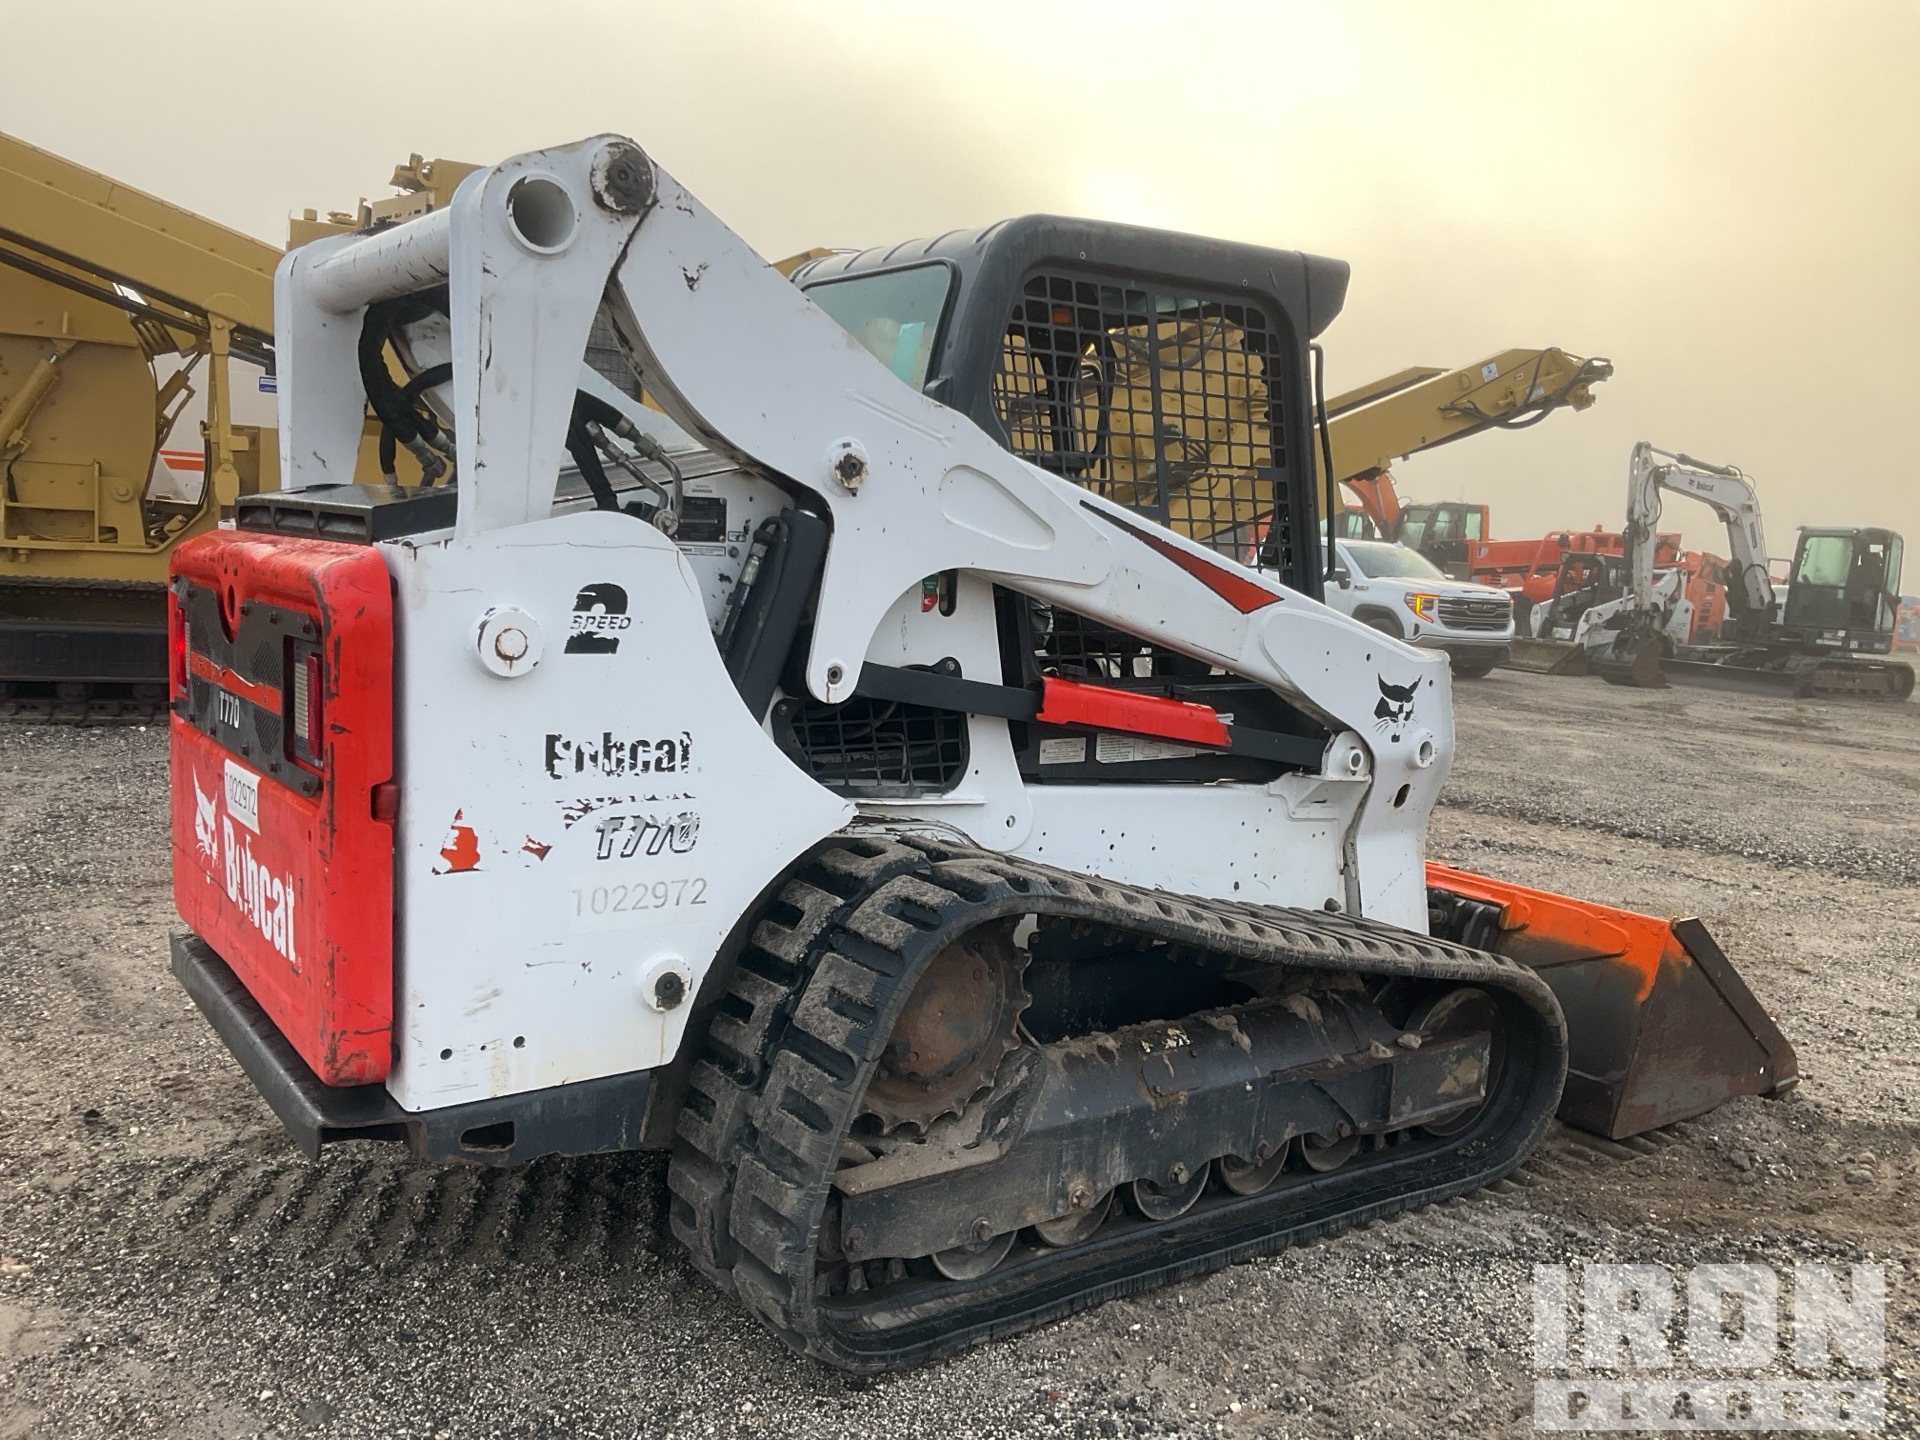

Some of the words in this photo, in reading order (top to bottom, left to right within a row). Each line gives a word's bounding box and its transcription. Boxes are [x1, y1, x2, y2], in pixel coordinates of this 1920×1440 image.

[1696, 481, 1714, 492] Bobcat
[564, 583, 628, 654] 2
[570, 615, 632, 629] SPEED
[219, 690, 240, 729] T770
[595, 811, 701, 861] T770
[223, 814, 296, 964] Bobcat
[572, 877, 708, 917] 1022972
